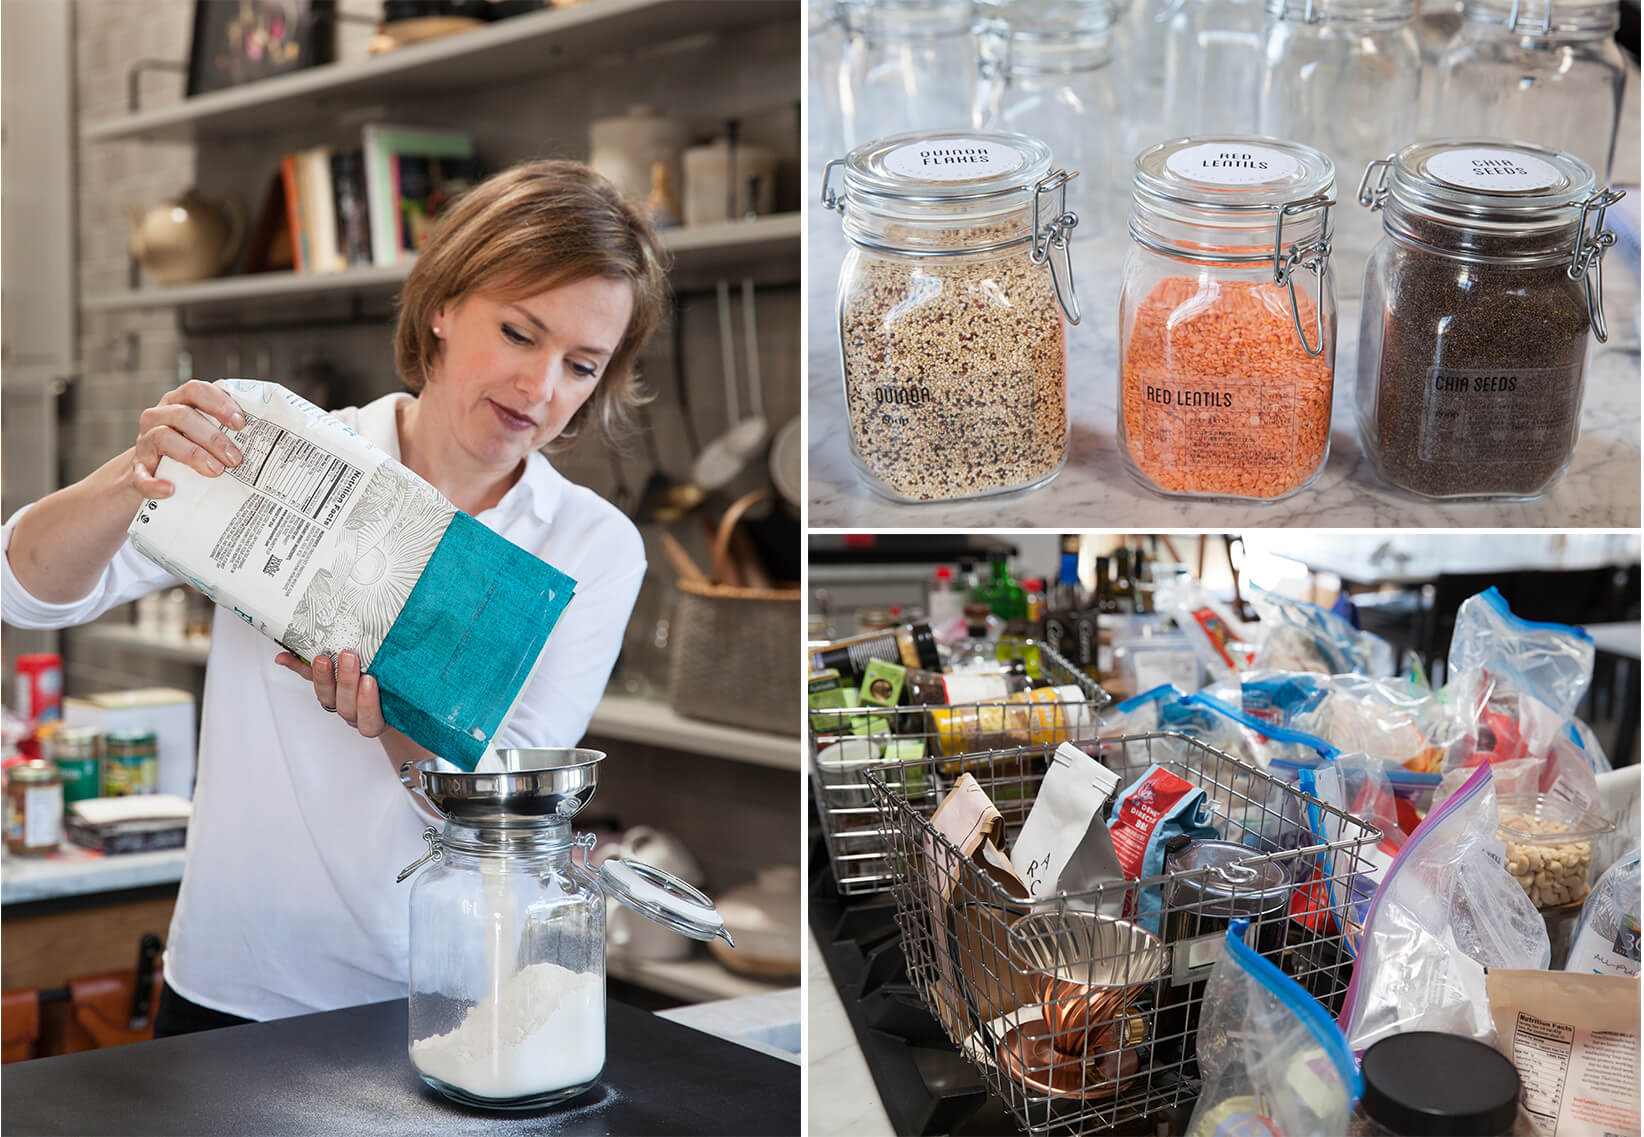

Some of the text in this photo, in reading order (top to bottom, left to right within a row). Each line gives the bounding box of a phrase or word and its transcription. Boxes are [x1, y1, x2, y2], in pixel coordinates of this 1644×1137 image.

[920, 148, 988, 158] QUINOA
[922, 156, 989, 166] FLAKES
[1202, 160, 1268, 169] LENTILS
[1471, 159, 1514, 167] CHIA
[1472, 167, 1528, 176] SEEDS
[1435, 375, 1518, 392] CHIA SEEDS
[875, 387, 931, 404] QUINOA
[1147, 385, 1232, 408] RED LENTILS
[323, 470, 362, 526] Nutrition Facts
[1519, 1014, 1572, 1032] Nutrition Facts
